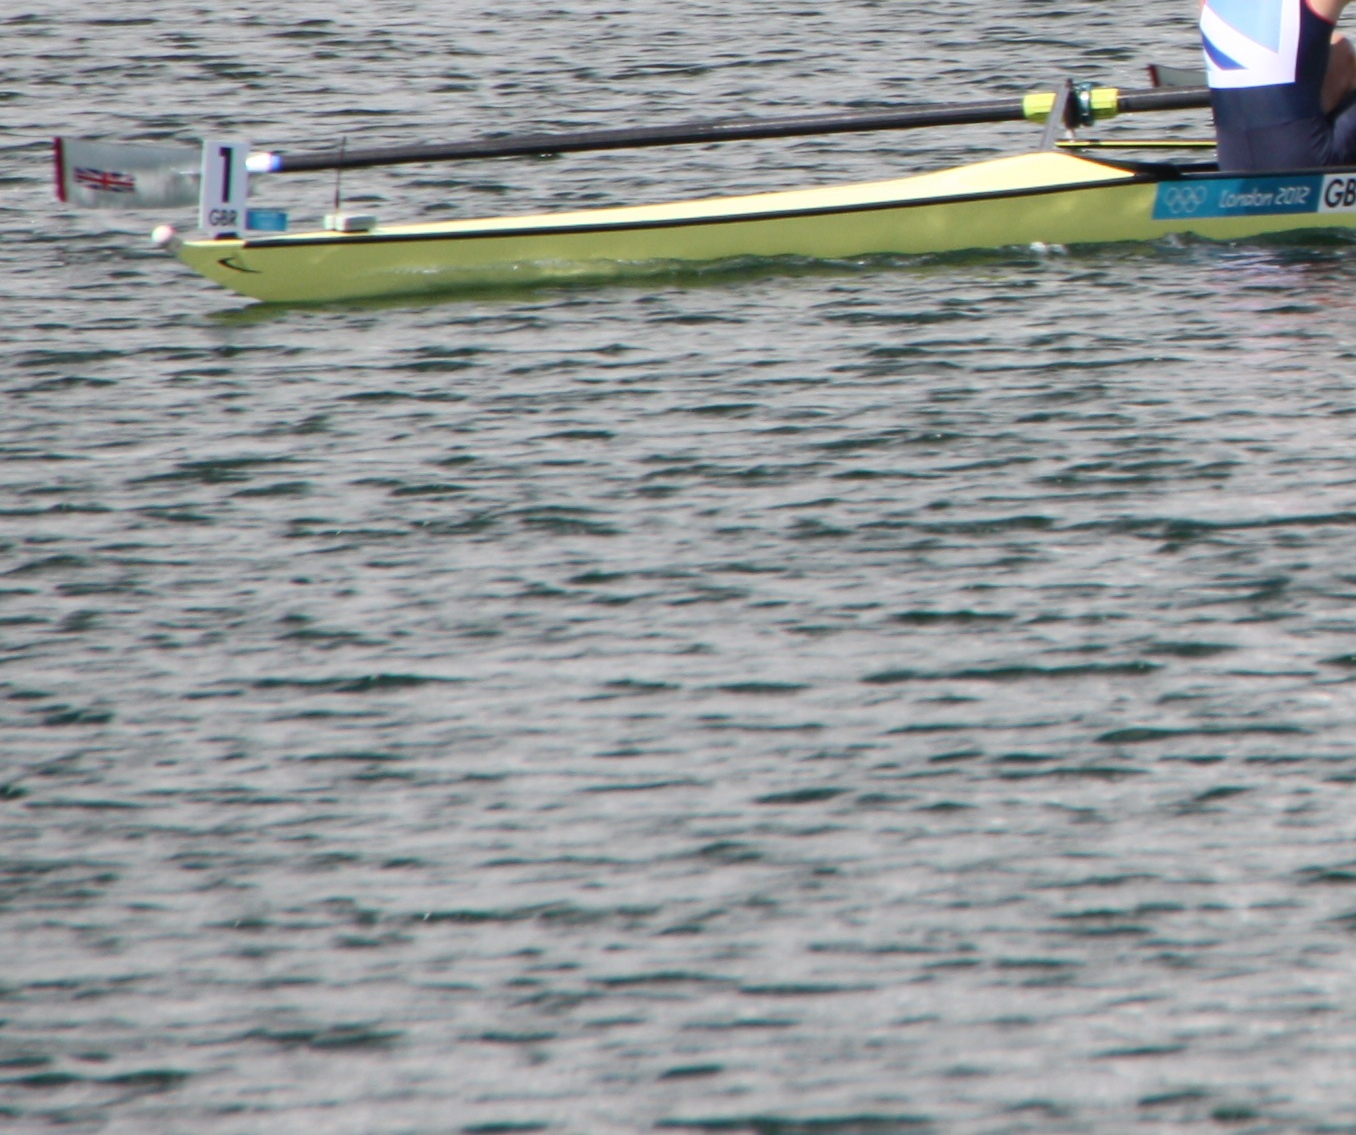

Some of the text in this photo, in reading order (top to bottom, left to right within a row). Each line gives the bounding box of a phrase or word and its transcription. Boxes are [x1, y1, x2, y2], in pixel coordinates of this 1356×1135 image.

[218, 146, 233, 203] 1
[1218, 185, 1311, 208] London 2012
[208, 208, 238, 227] GBR
